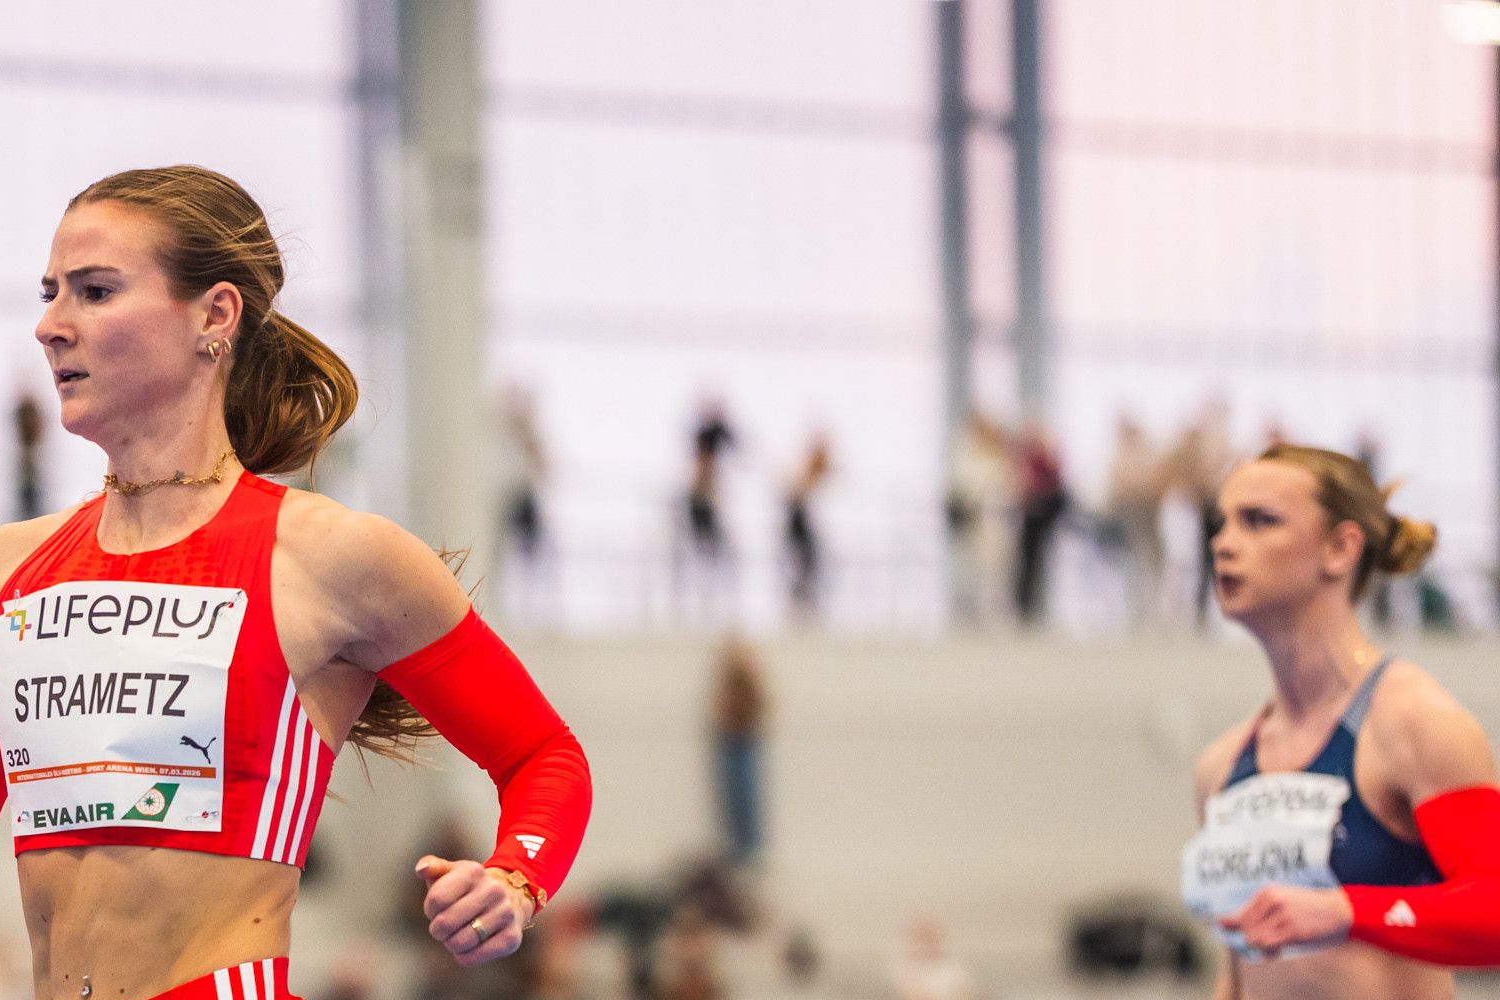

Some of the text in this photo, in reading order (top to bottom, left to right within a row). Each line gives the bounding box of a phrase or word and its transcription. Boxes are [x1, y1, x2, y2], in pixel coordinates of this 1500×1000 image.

[14, 672, 190, 723] STRAMETZ
[6, 747, 31, 767] 320
[106, 764, 133, 773] ARENA
